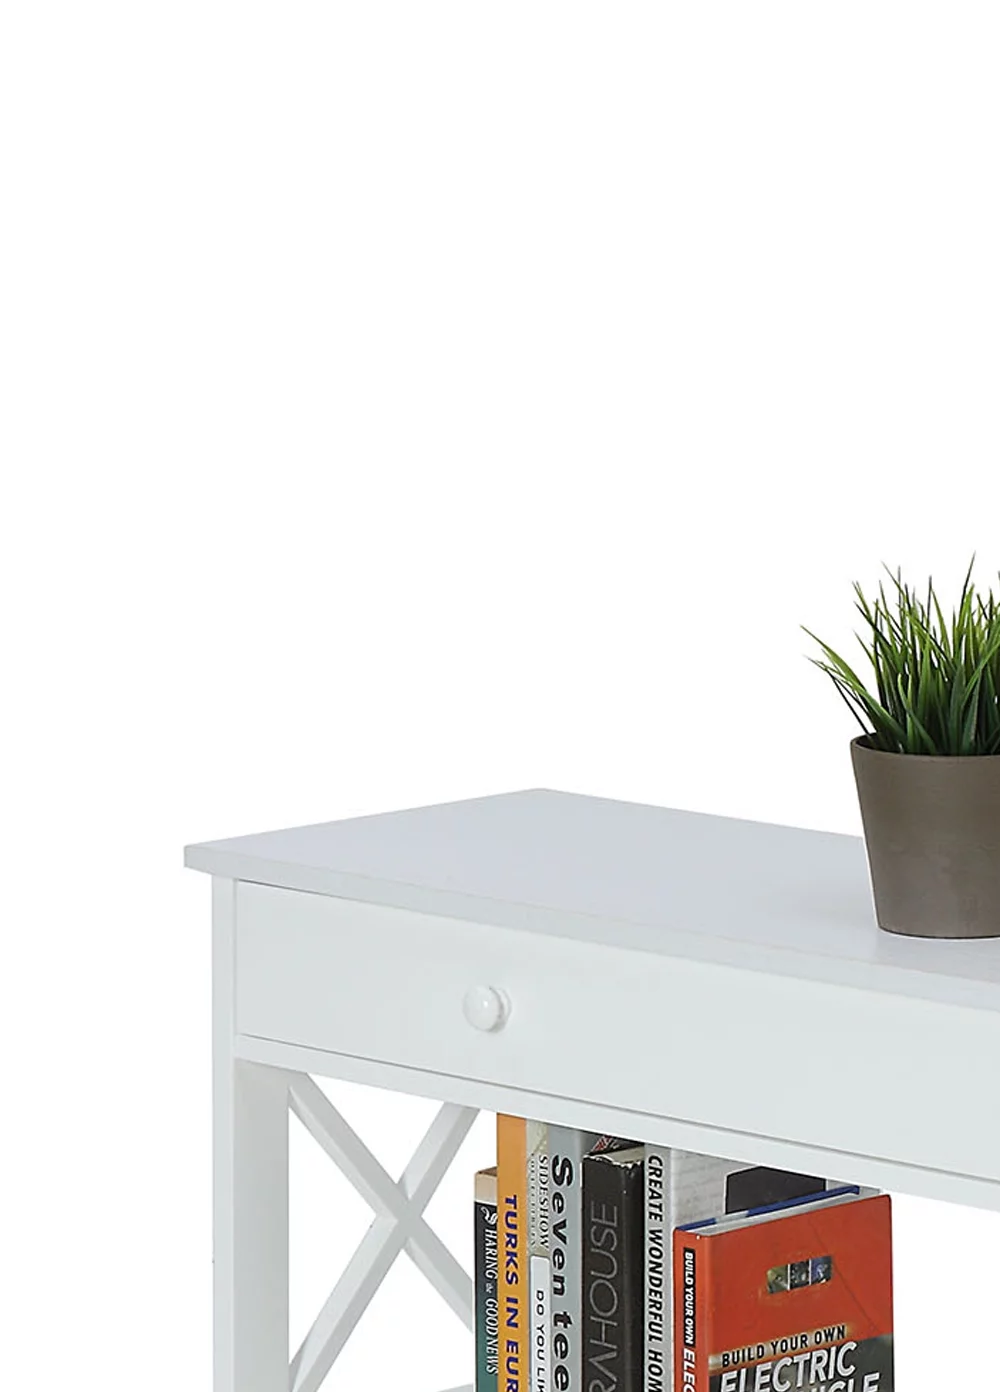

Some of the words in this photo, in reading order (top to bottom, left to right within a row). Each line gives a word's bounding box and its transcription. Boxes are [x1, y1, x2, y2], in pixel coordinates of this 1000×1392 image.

[538, 1153, 549, 1249] SIDESHOW
[648, 1154, 663, 1222] CREATE
[505, 1194, 519, 1286] TURKS
[648, 1229, 663, 1342] WONDERFUL
[684, 1251, 694, 1285] BUILD
[485, 1298, 498, 1334] GOOD
[505, 1296, 519, 1329] IN
[536, 1290, 545, 1316] DO
[685, 1287, 694, 1316] YOUR
[536, 1324, 545, 1361] YOU
[685, 1317, 694, 1345] OWN
[722, 1344, 765, 1368] BUILD
[770, 1334, 808, 1355] YOUR
[814, 1325, 846, 1345] OWN
[485, 1336, 498, 1375] NEWS
